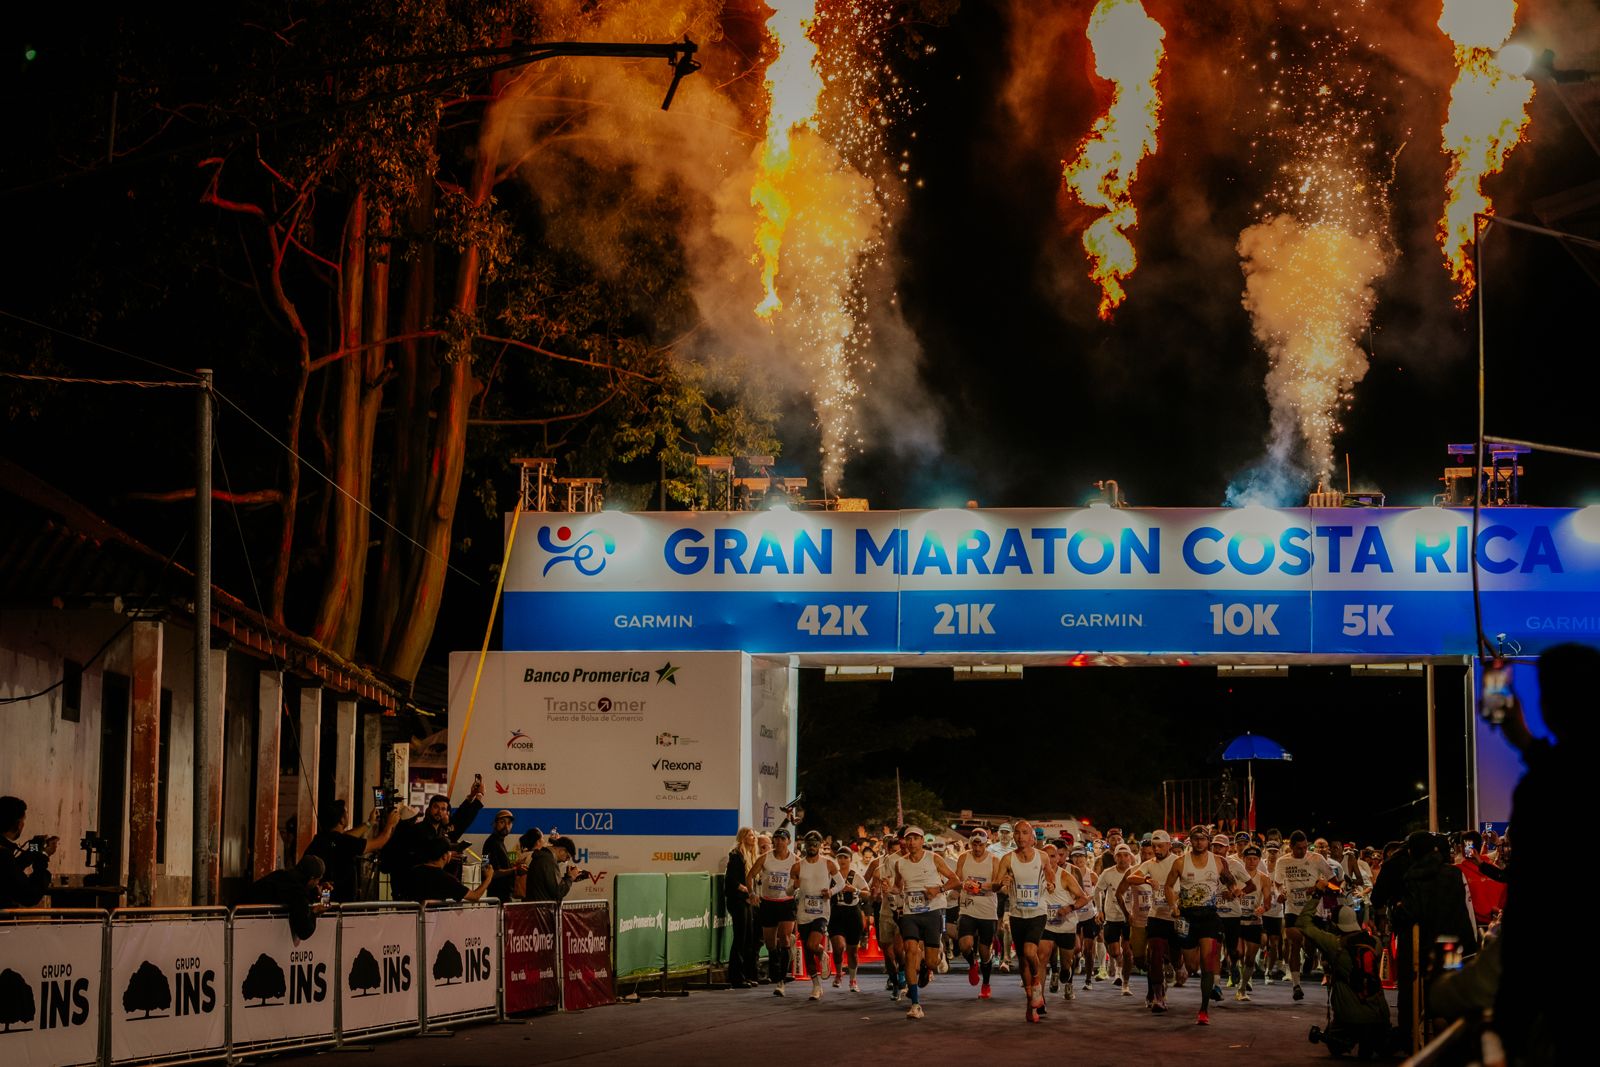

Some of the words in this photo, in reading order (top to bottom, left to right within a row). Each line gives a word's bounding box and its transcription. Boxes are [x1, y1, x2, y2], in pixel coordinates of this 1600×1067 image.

[663, 528, 833, 576] GRAN
[855, 527, 1161, 576] MARATON
[1182, 526, 1394, 576] COSTA
[1415, 525, 1565, 574] RICA
[614, 615, 694, 629] GARMIN
[797, 604, 869, 636] 42K
[933, 603, 996, 635] 21K
[1060, 613, 1144, 628] GARMIN
[1210, 604, 1280, 636] 10K
[1342, 604, 1395, 636] 5K
[523, 668, 570, 683] Banco
[572, 667, 650, 683] Promerica
[543, 696, 647, 713] Transcomer
[546, 714, 569, 722] Puesto
[570, 714, 580, 722] de
[581, 714, 600, 722] Bolsa
[600, 714, 610, 722] de
[611, 714, 644, 722] Comercio
[494, 762, 547, 771] GATORADE
[661, 759, 702, 771] Rexona
[651, 852, 701, 861] SUBWAY
[1020, 889, 1032, 898] 101
[382, 944, 401, 955] GRUPO
[465, 937, 482, 948] GRUPO
[175, 957, 200, 971] GRUPO
[290, 951, 313, 963] GRUPO
[465, 946, 491, 983] INS
[41, 963, 73, 979] GRUPO
[382, 955, 411, 994] INS
[289, 962, 327, 1005] INS
[175, 970, 216, 1017] INS
[40, 977, 90, 1030] INS
